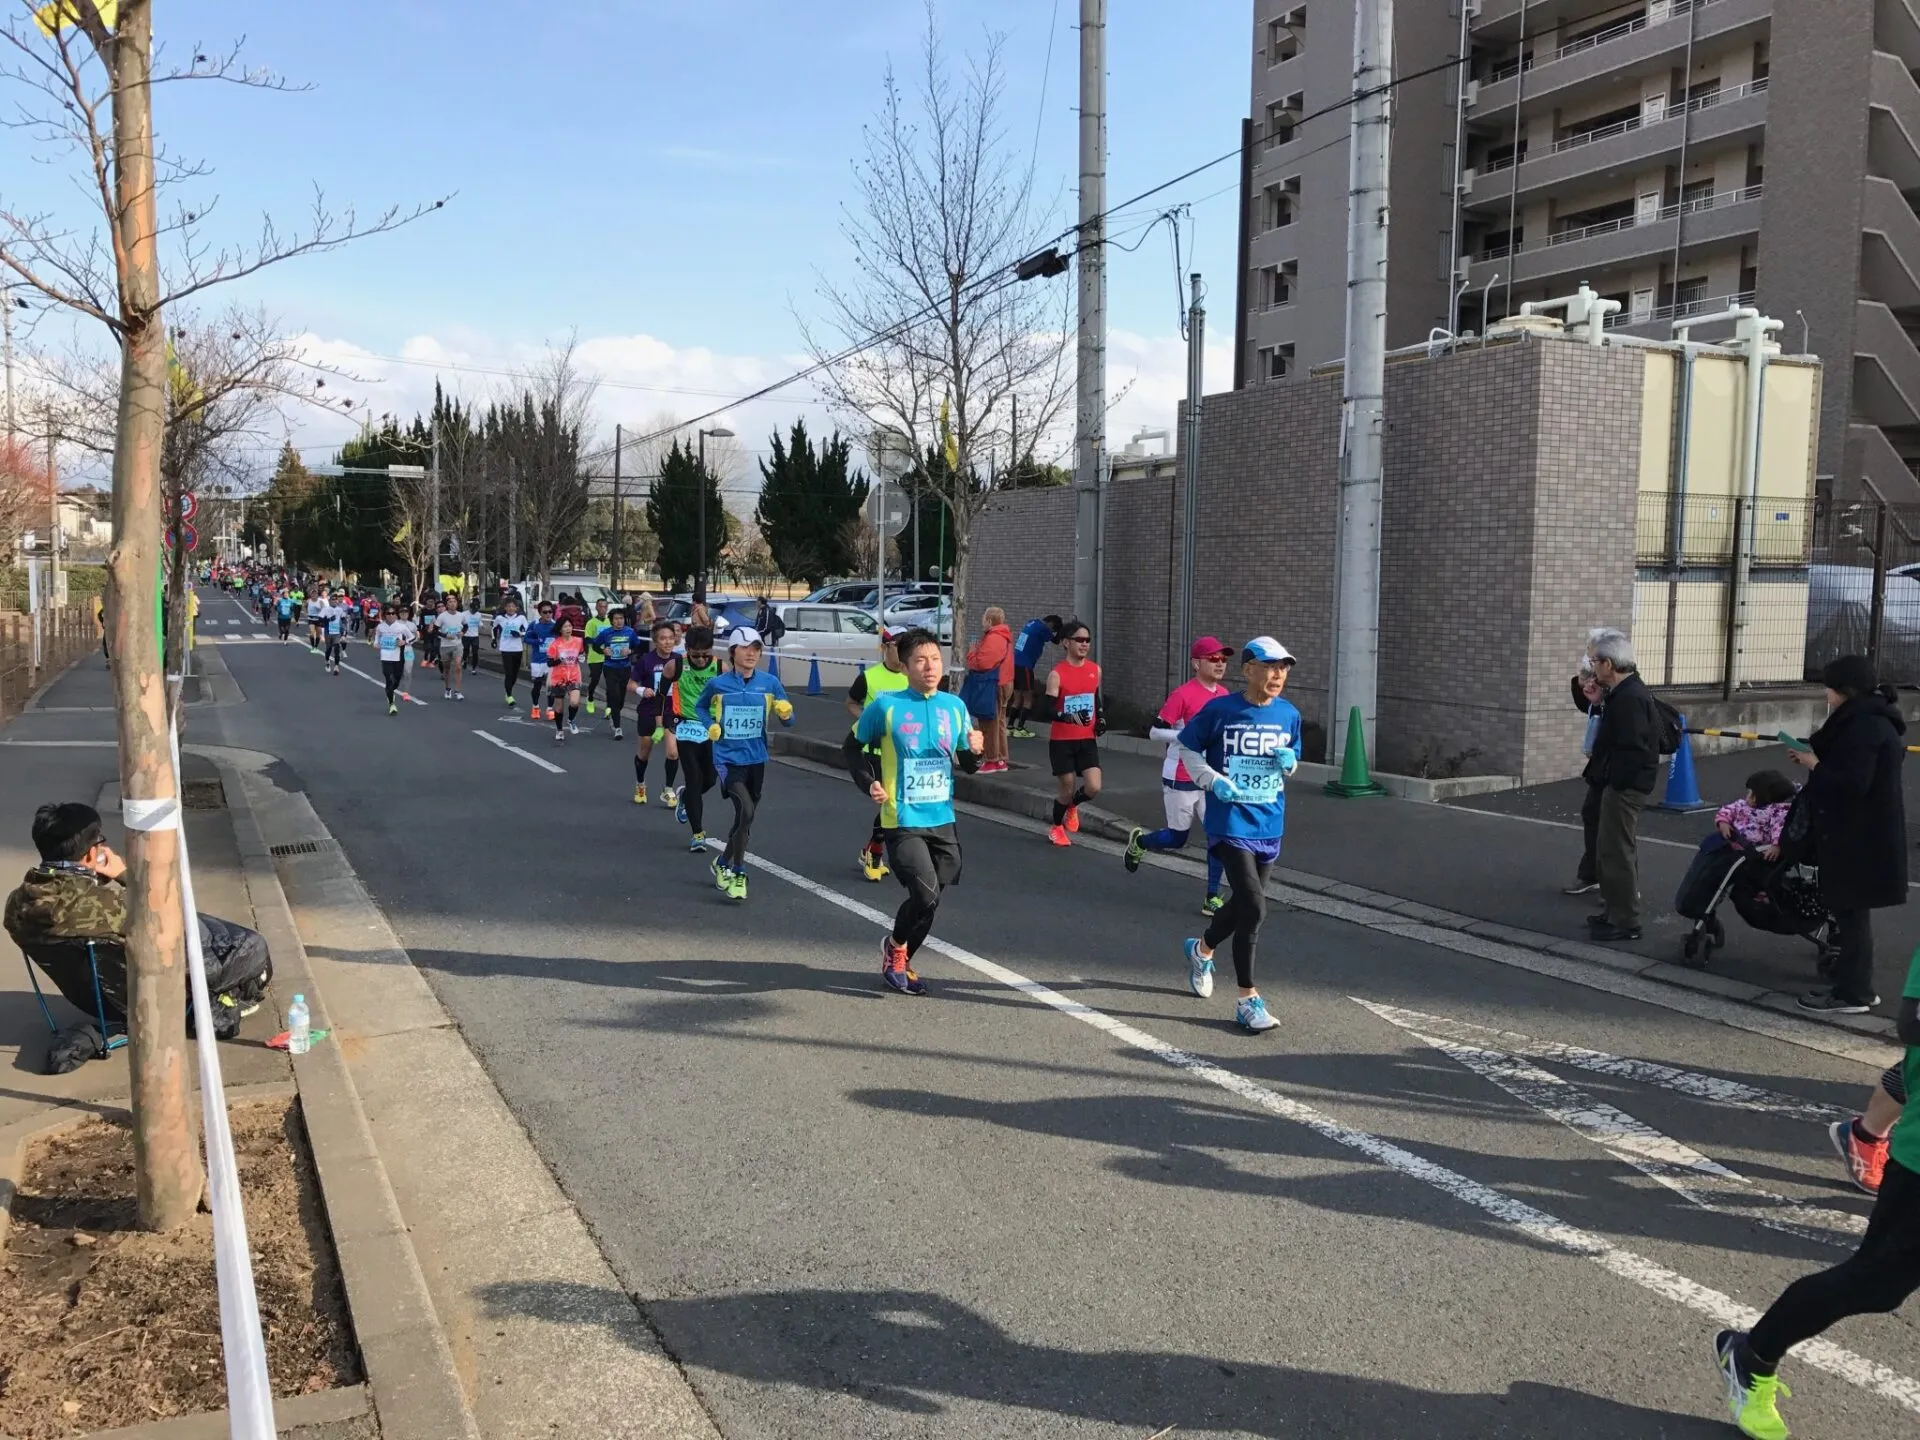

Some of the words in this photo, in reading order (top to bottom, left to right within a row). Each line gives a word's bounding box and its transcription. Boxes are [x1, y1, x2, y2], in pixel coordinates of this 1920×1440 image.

[725, 718, 762, 729] 4145D
[915, 759, 944, 767] HITACHI
[1240, 758, 1274, 766] HITACHI
